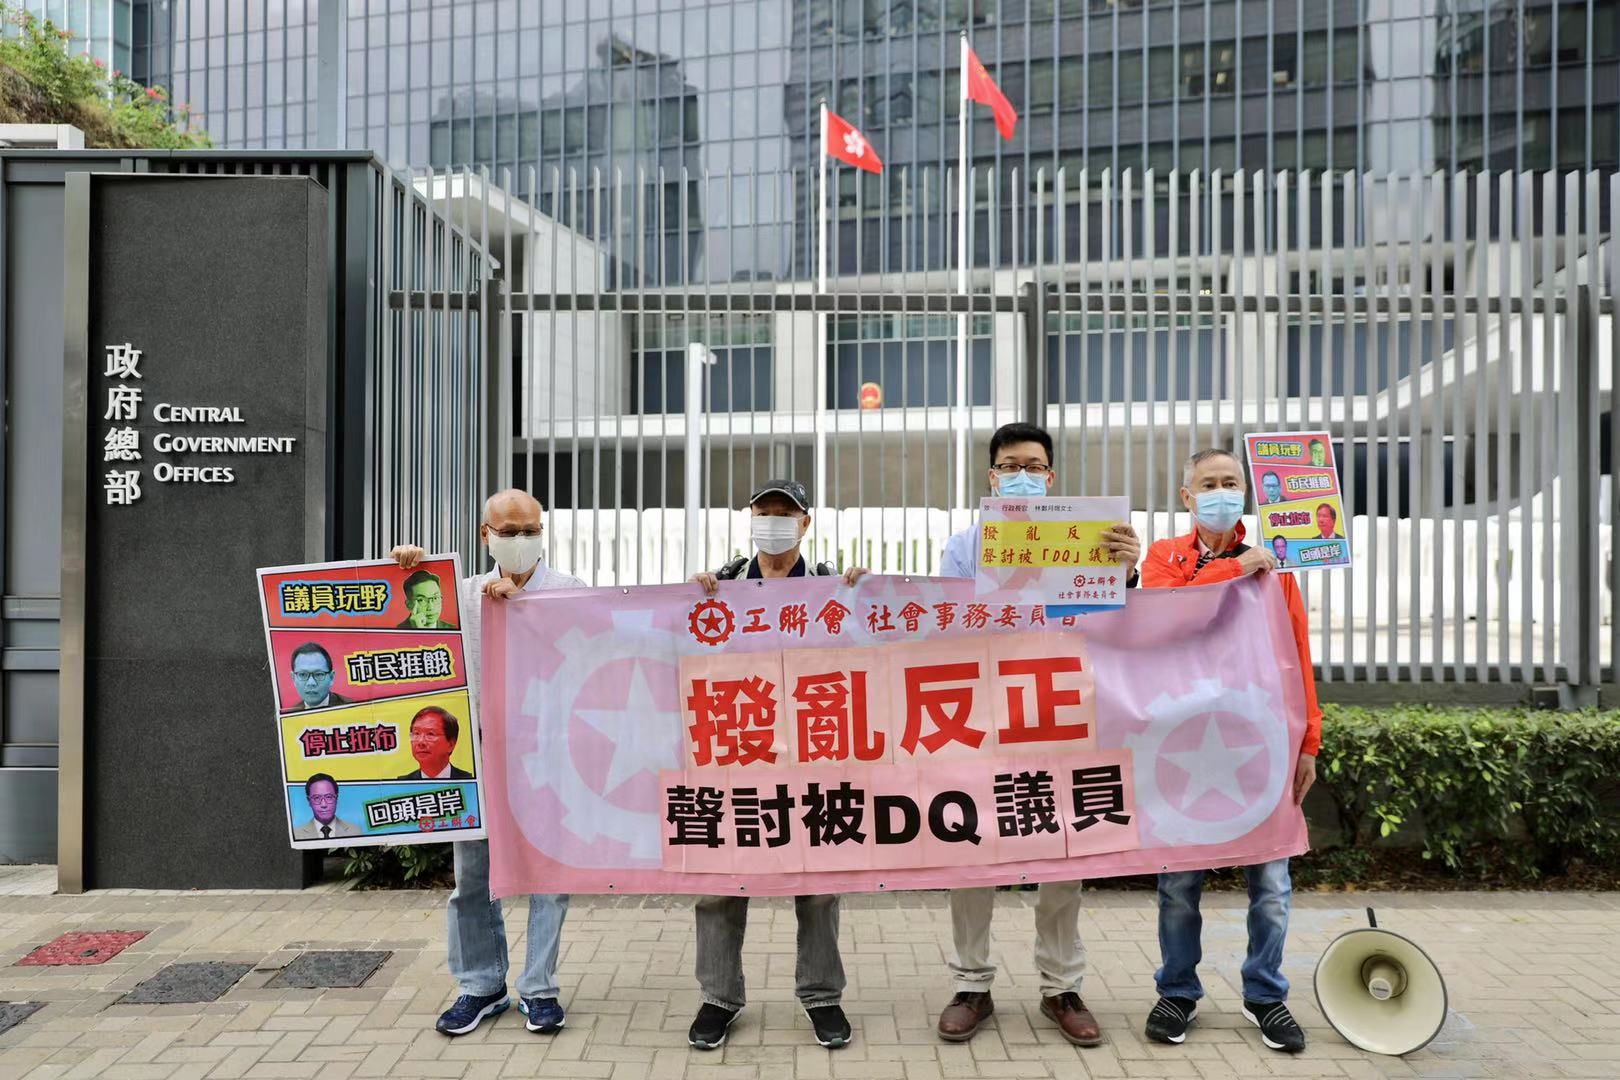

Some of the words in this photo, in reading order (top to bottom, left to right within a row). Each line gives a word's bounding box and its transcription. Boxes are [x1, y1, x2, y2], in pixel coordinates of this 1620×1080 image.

[104, 341, 143, 506] 政府總部
[153, 403, 245, 424] CENTRAL
[153, 433, 297, 454] GOVERNMENT
[153, 462, 236, 484] OFFICES
[282, 582, 388, 613] 議員玩野
[742, 599, 852, 637] 工聯會
[349, 649, 452, 683] 市民捱餓
[687, 656, 1089, 767] 撥亂反正
[301, 724, 396, 758] 停止拉布
[367, 790, 464, 829] 回頭是岸
[665, 763, 1132, 849] 聲討被DQ議員
